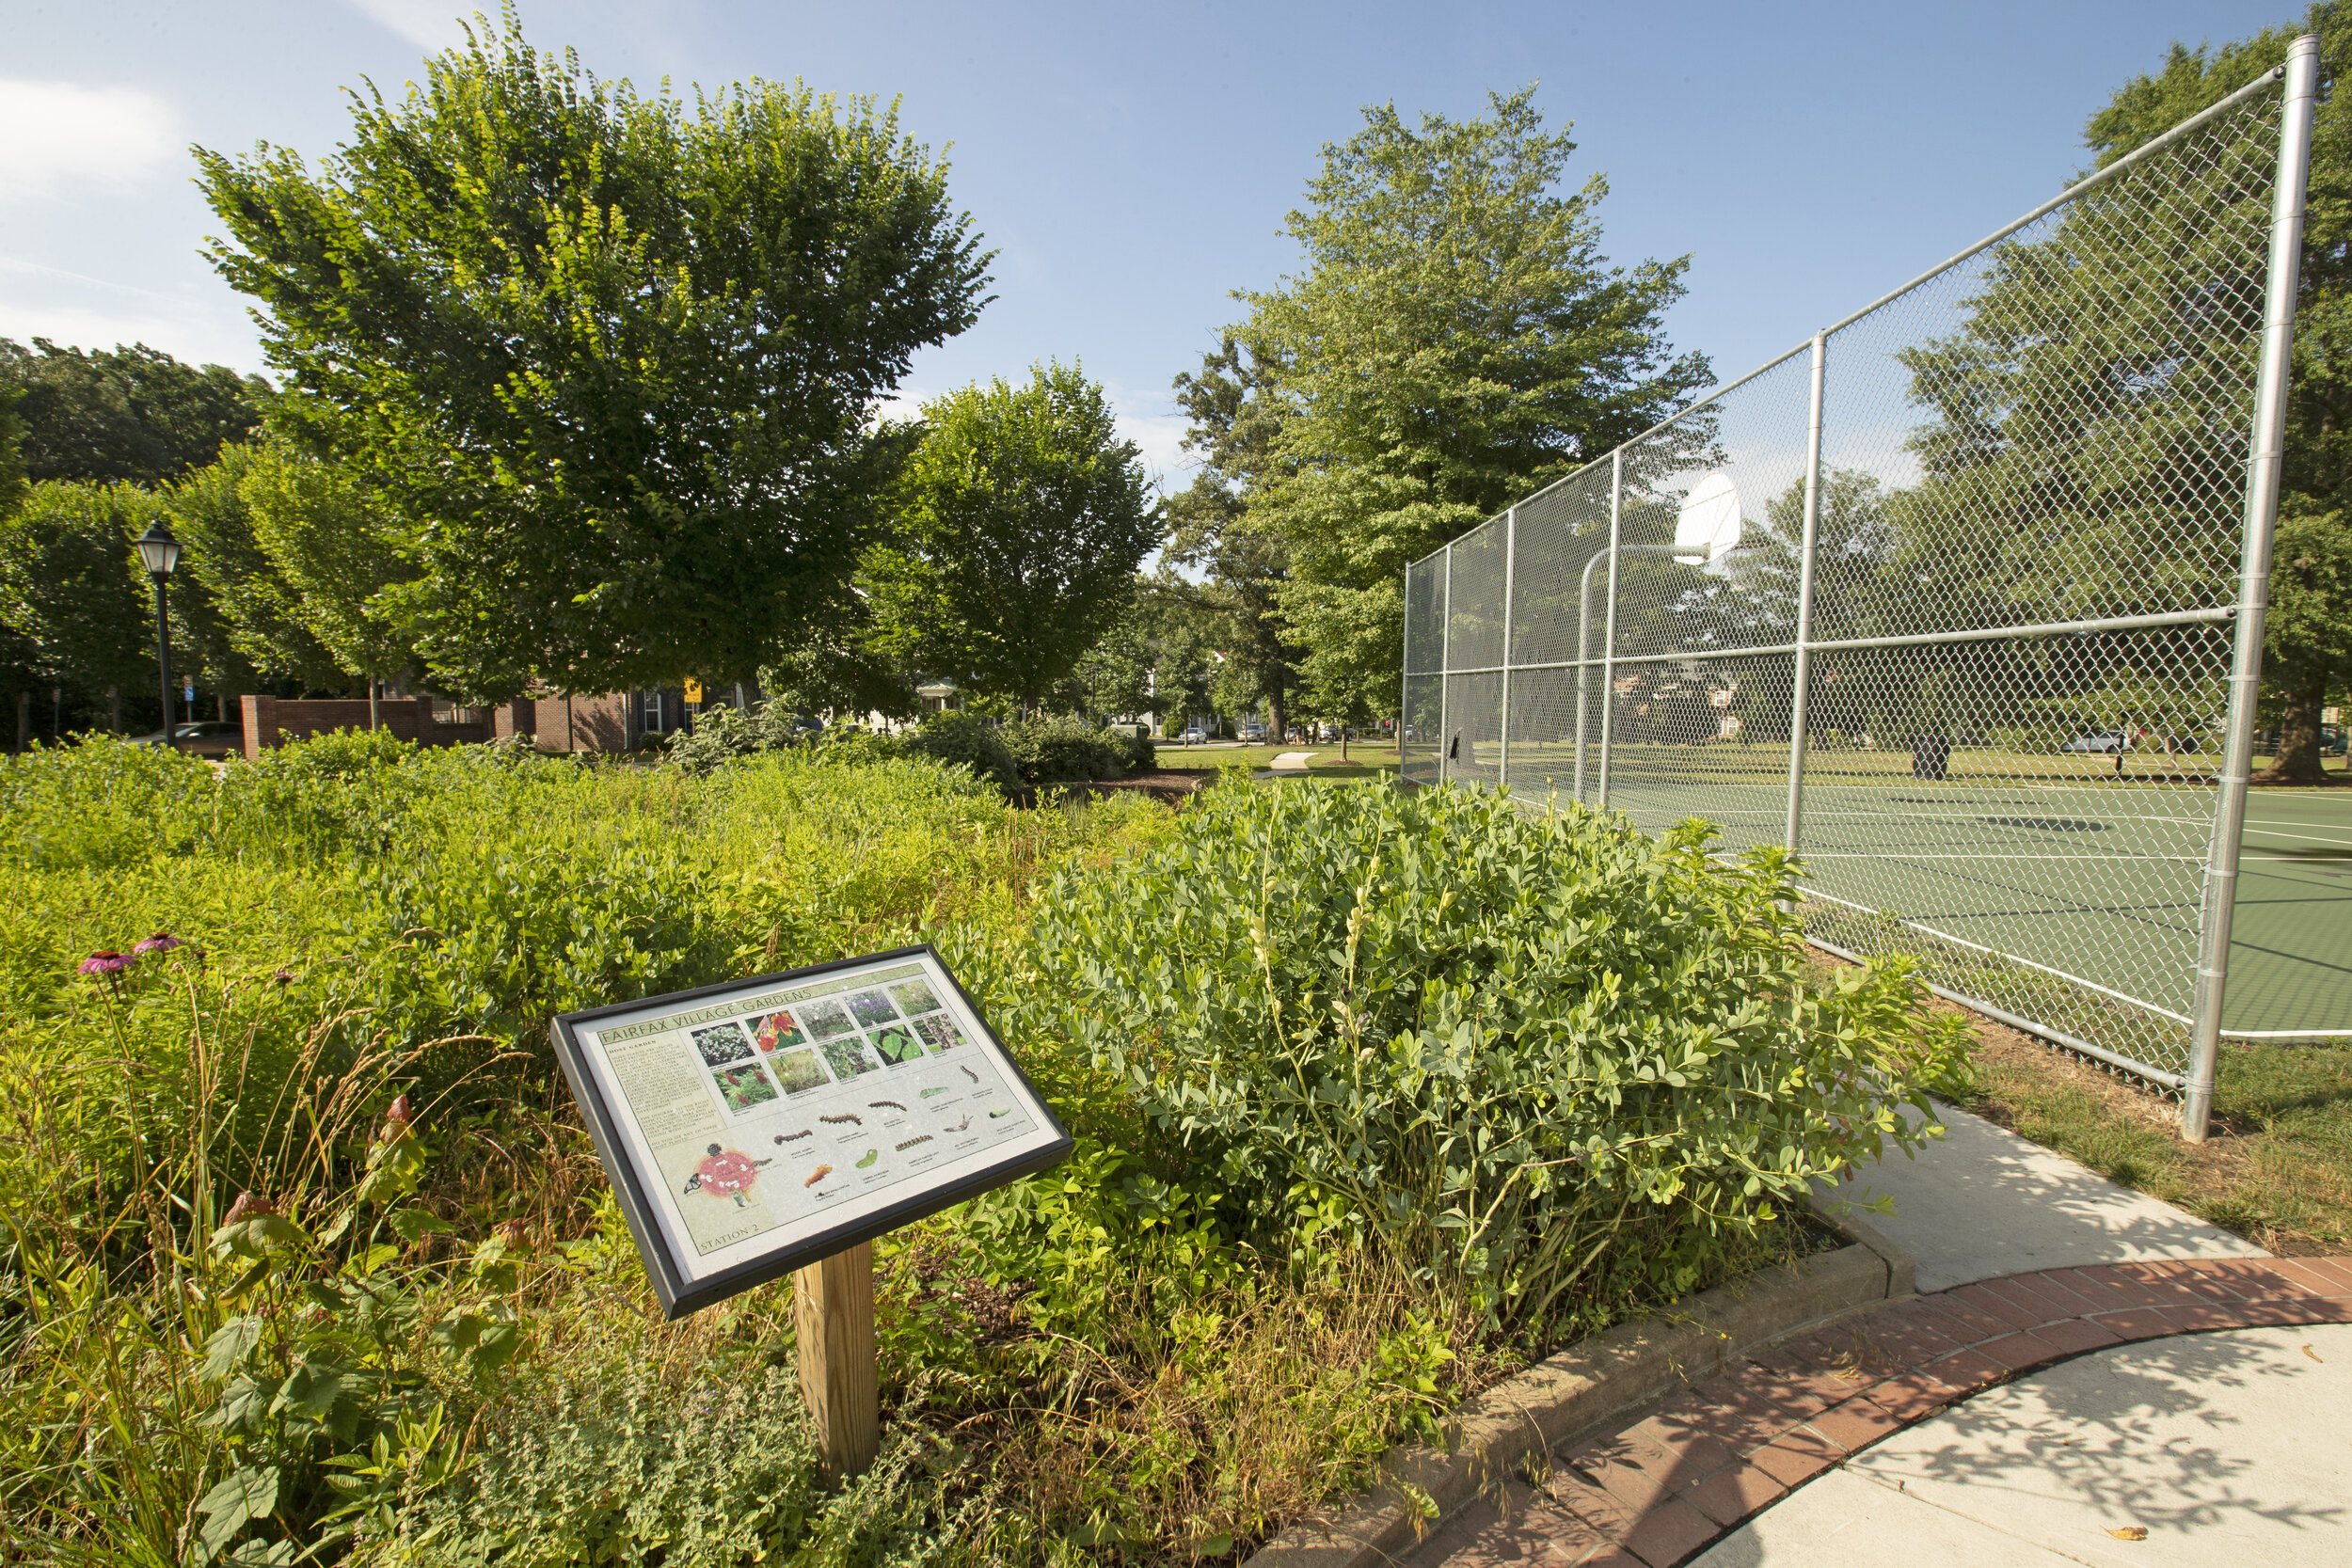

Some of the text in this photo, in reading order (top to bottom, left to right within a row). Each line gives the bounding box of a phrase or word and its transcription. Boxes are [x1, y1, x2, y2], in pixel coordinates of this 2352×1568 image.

[602, 989, 812, 1042] FAIRFAX VILLAGE GARDENS
[628, 1040, 657, 1050] GARDEN
[700, 1223, 759, 1251] STATION 2
